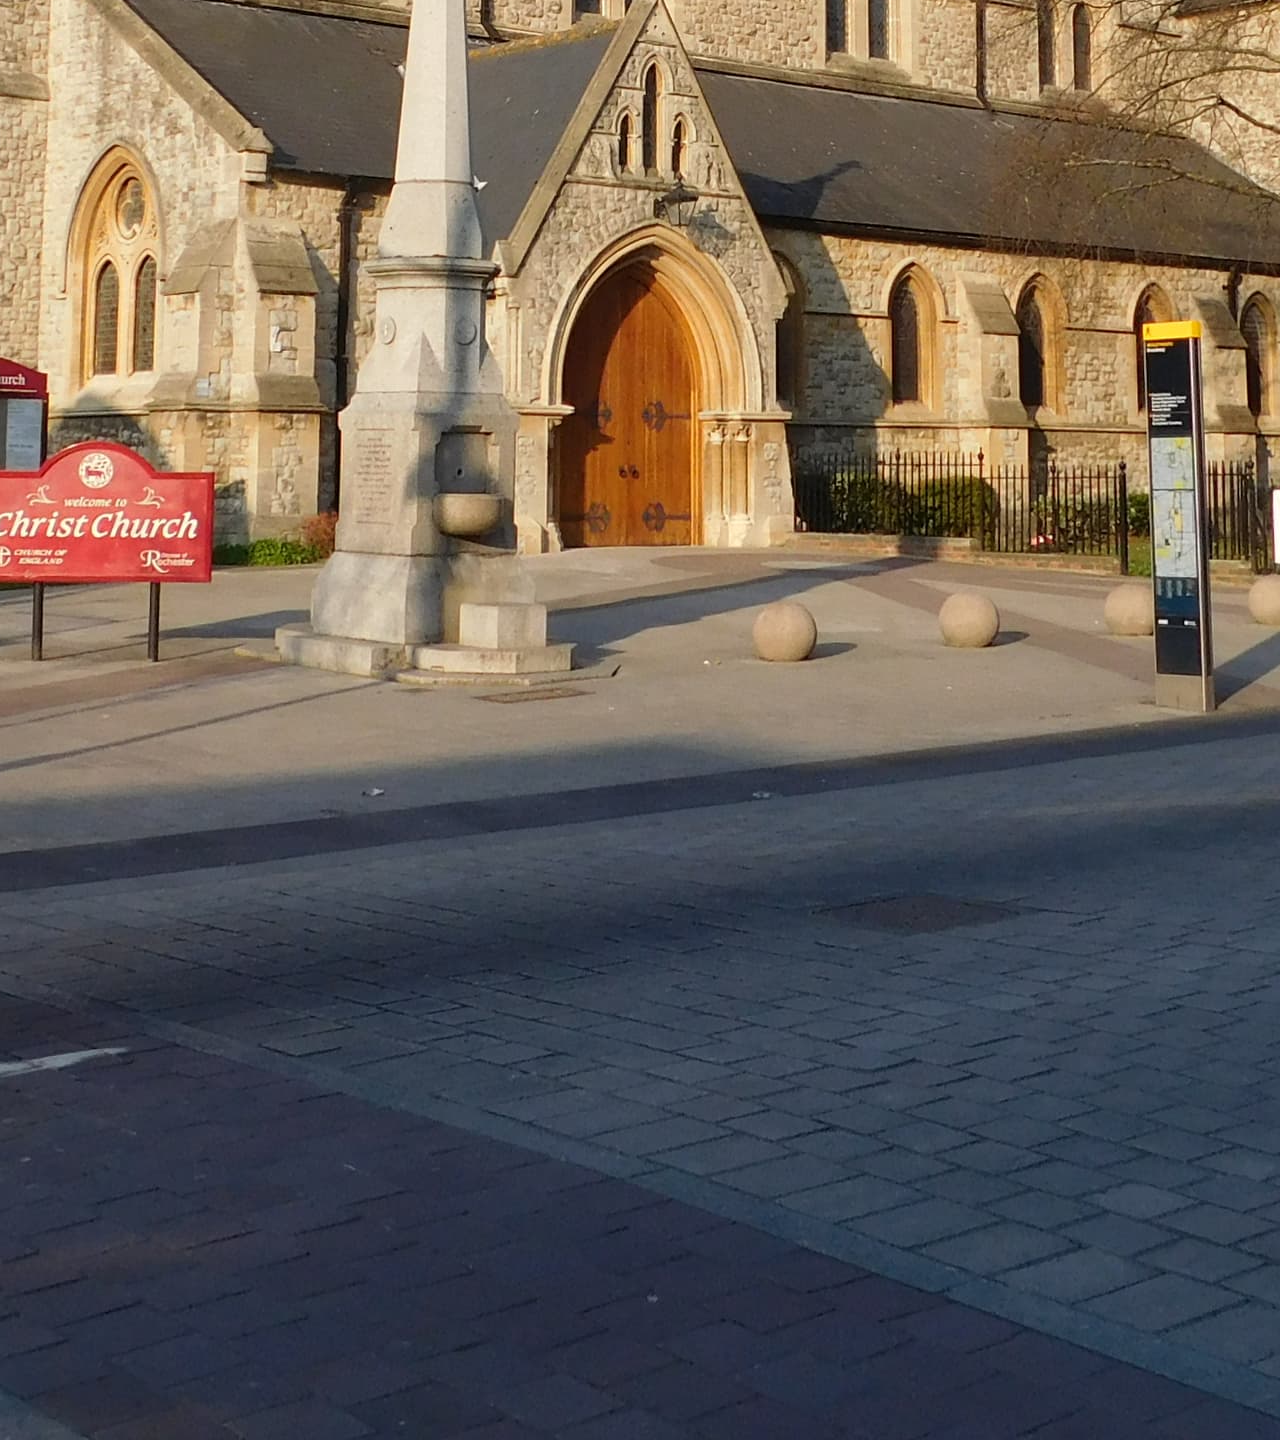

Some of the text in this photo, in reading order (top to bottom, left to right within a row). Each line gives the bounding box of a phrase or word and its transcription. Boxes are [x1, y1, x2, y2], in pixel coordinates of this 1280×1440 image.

[64, 496, 128, 508] welcome to
[91, 510, 199, 540] Church
[14, 548, 53, 556] CHURCH
[18, 557, 64, 565] ENGLAND
[140, 549, 196, 574] Rochester
